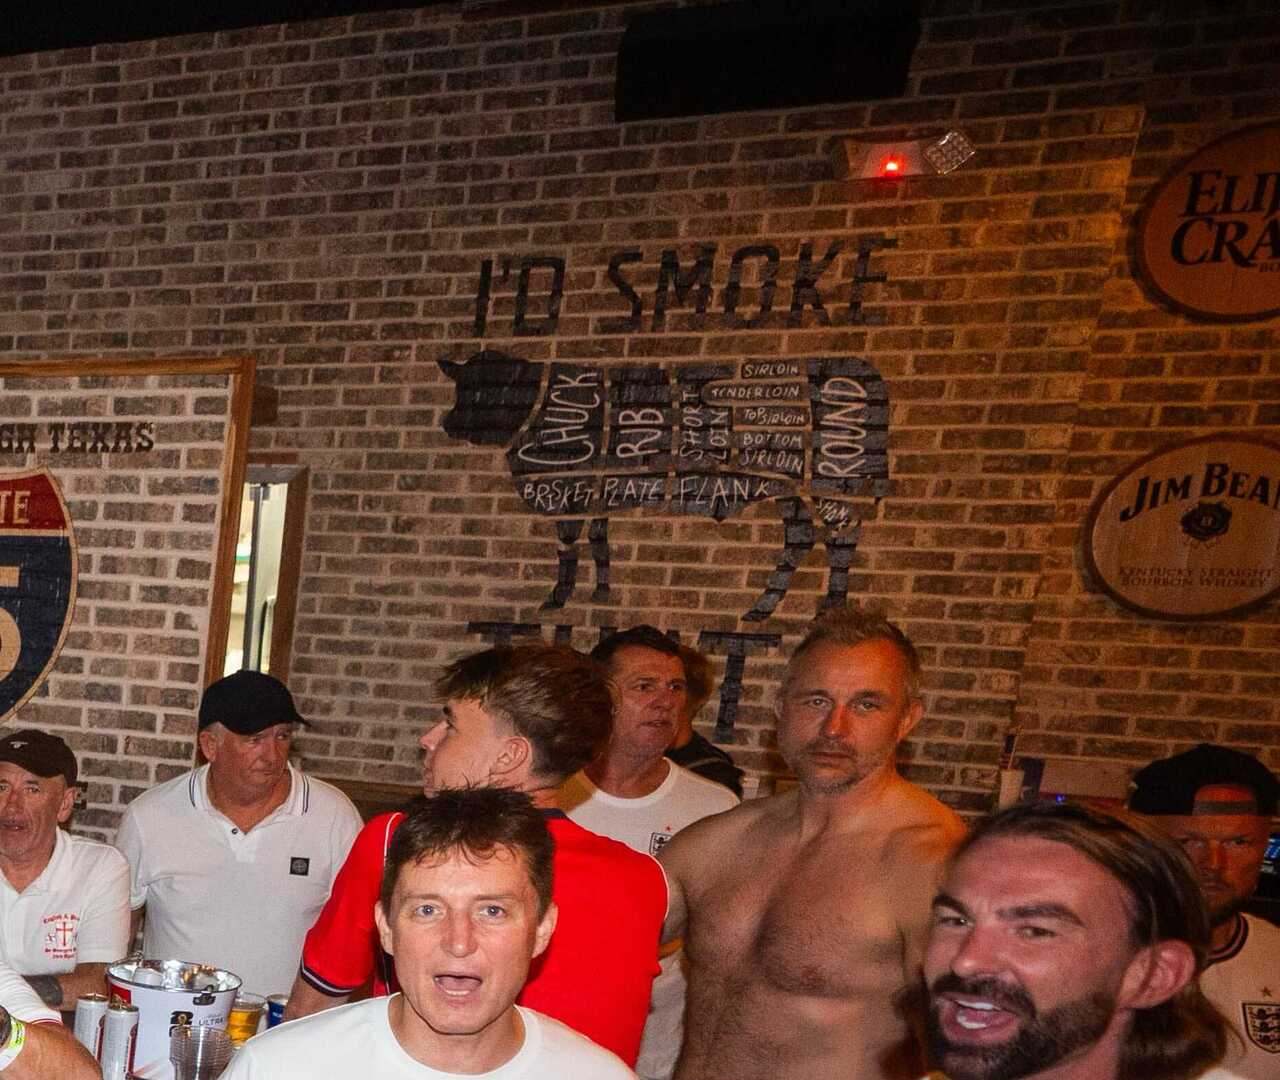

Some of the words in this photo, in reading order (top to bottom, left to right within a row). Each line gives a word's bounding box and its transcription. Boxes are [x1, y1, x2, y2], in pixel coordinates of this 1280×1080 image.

[600, 237, 898, 334] SMOKE
[744, 364, 799, 377] SIRLOIN
[711, 385, 800, 398] TENDERLOIN
[518, 373, 600, 465] CHUCK
[679, 391, 704, 460] SHORT
[710, 410, 729, 460] LOIN
[818, 377, 868, 478] ROUND
[48, 421, 156, 454] TEXAS
[743, 433, 803, 446] BOTTOM
[739, 449, 804, 473] SIRLOIN
[523, 480, 594, 511] BRISKET
[603, 478, 663, 506] PLATE
[680, 475, 770, 510] FLANK
[1119, 474, 1192, 522] JIM
